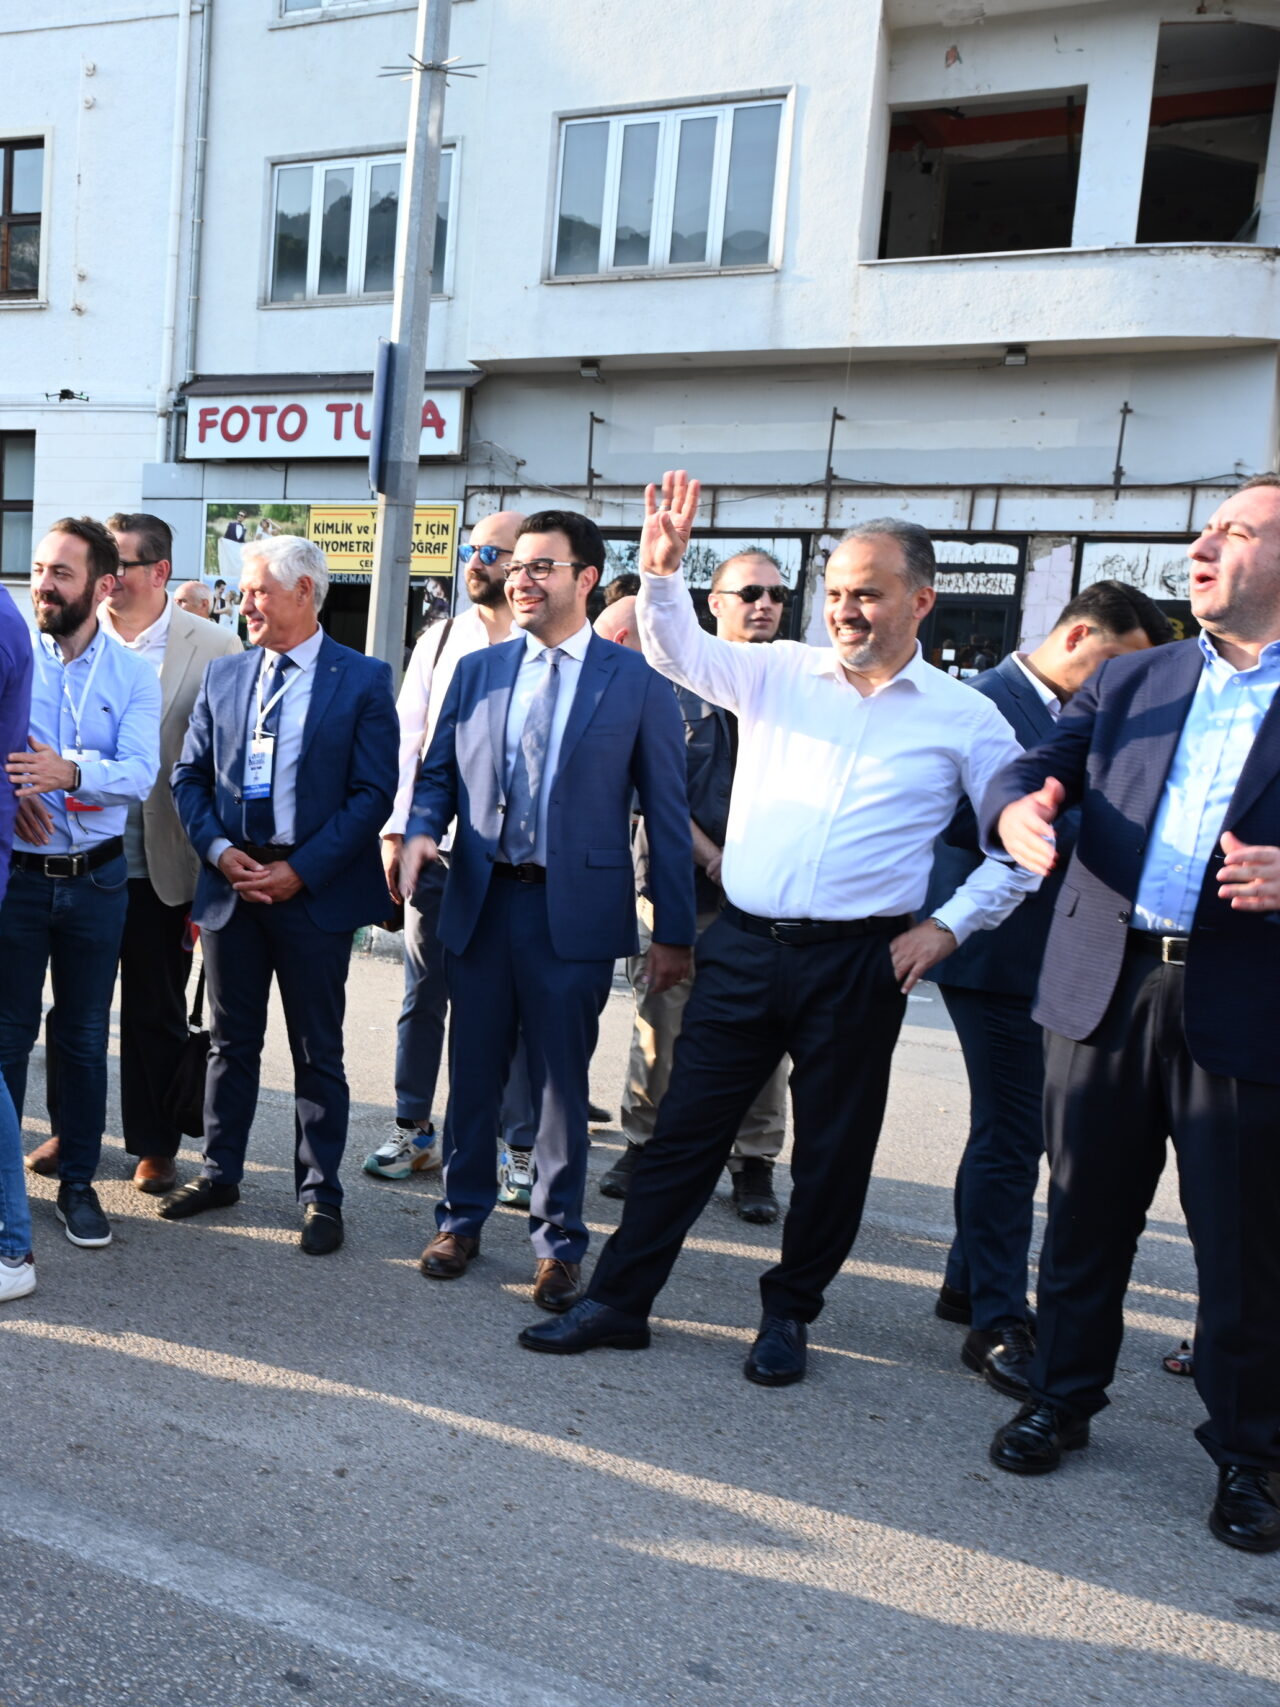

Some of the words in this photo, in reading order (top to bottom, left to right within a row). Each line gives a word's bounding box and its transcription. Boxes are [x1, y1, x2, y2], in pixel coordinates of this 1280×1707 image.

[198, 403, 308, 443] FOTO
[325, 399, 446, 441] TUA
[313, 520, 353, 535] KİMLİK
[356, 525, 370, 535] ve
[425, 520, 450, 540] İÇİN
[313, 539, 374, 553] İYOMETRİ
[410, 540, 448, 554] OĞRAF
